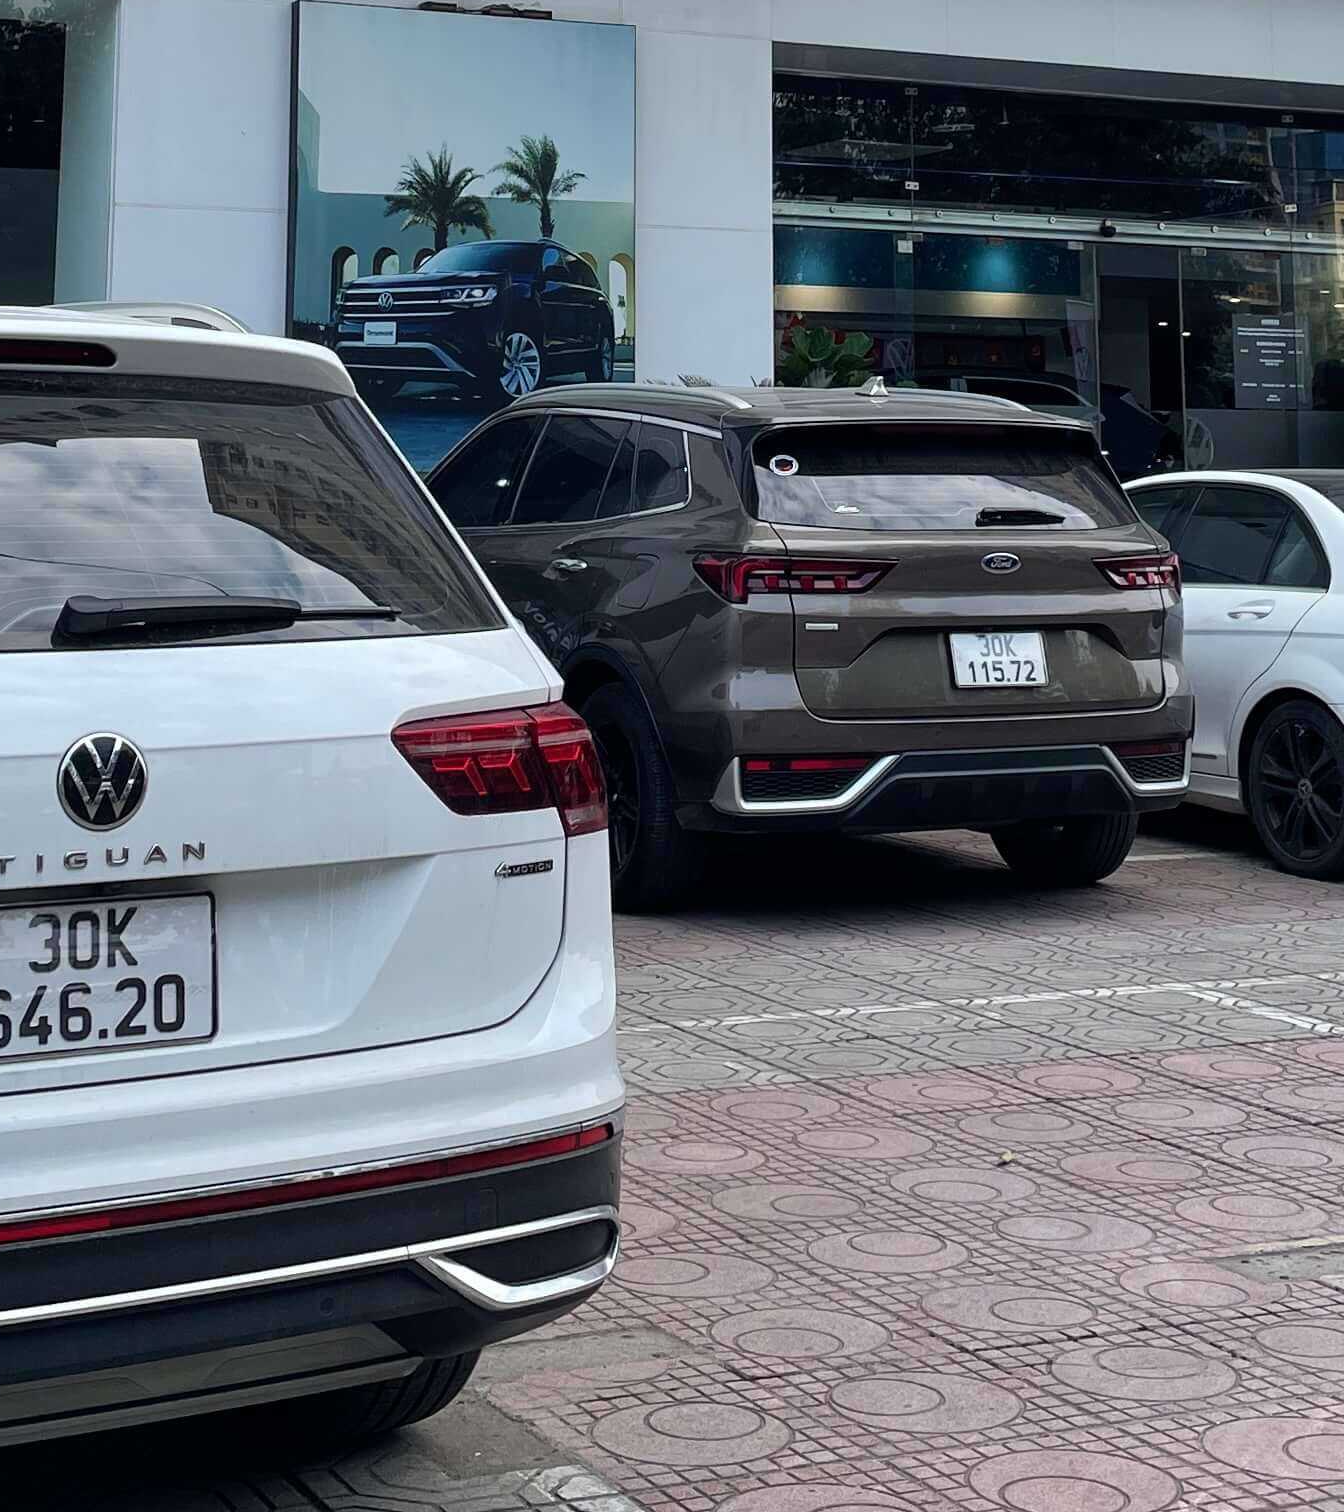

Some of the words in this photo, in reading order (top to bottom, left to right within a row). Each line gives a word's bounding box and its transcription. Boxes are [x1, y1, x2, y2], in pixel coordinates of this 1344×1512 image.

[978, 635, 1016, 657] 30K
[968, 660, 1037, 683] 115.72
[27, 906, 141, 975] 30K
